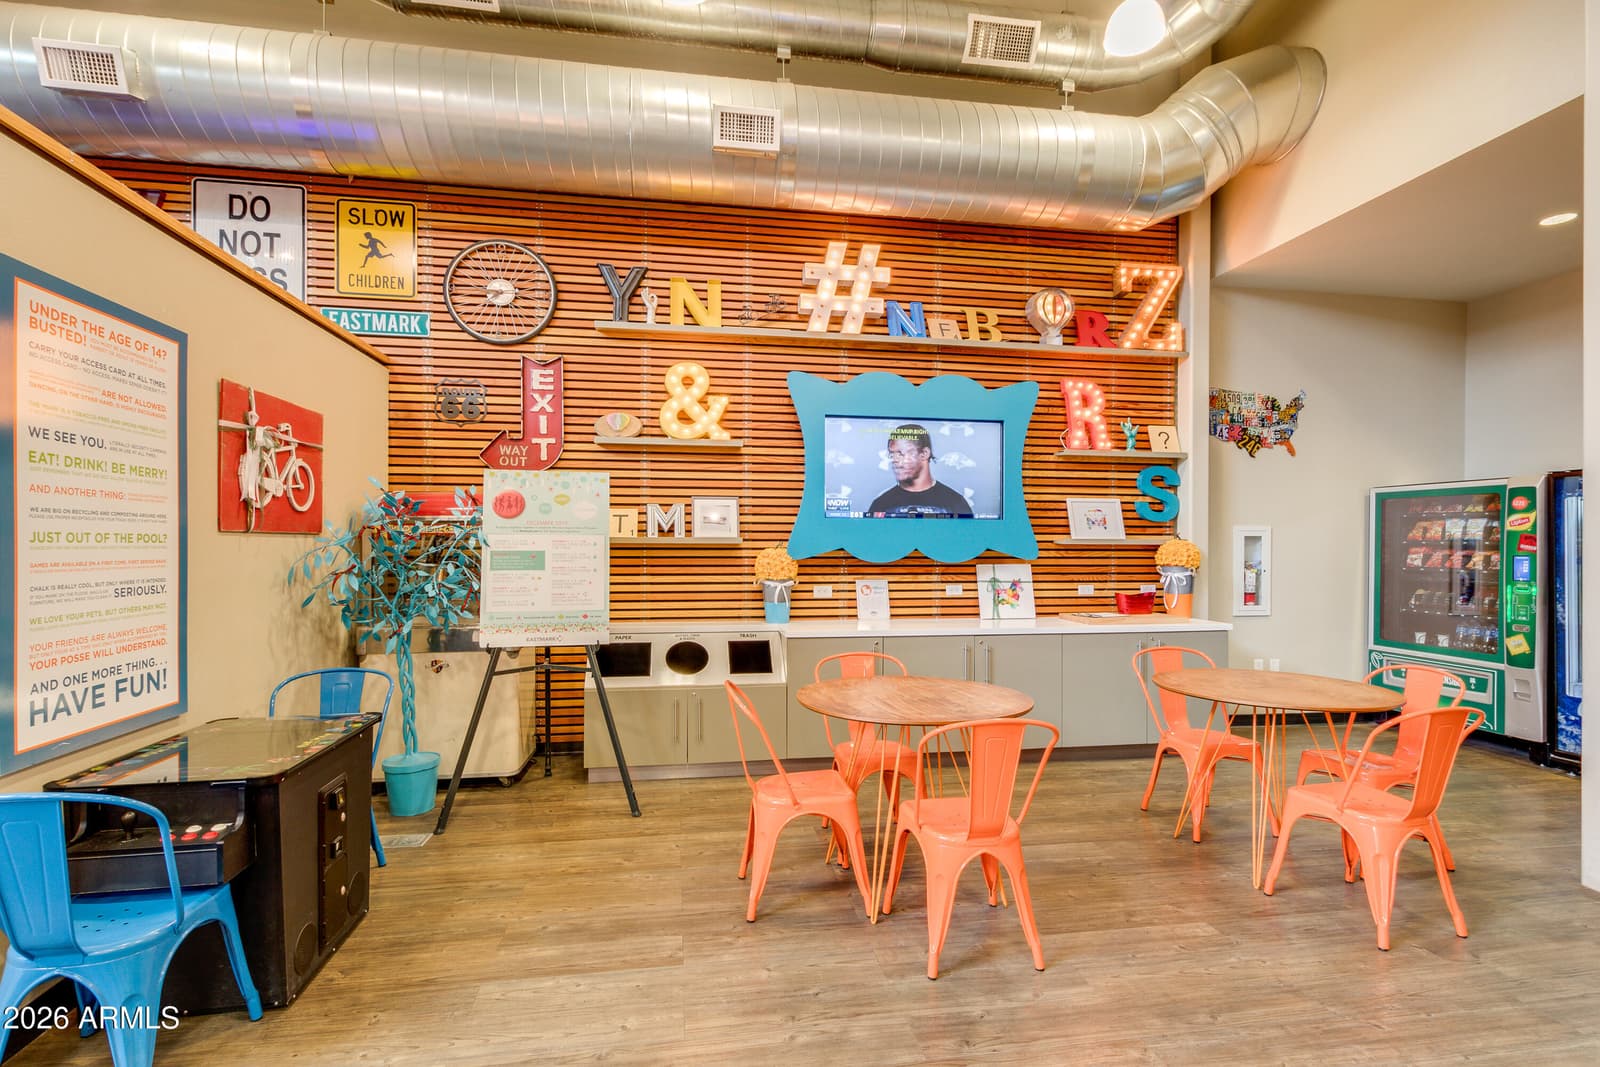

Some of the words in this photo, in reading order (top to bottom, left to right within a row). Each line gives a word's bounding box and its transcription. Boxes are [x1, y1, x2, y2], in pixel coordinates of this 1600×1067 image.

[228, 193, 271, 222] DO
[348, 208, 406, 228] SLOW
[219, 229, 281, 258] NOT
[348, 273, 405, 290] CHILDREN
[598, 263, 648, 322] Y
[670, 276, 722, 327] N
[886, 300, 927, 338] N
[960, 307, 1002, 342] B
[1075, 310, 1119, 348] R
[1113, 262, 1184, 350] Z
[30, 299, 78, 328] UNDER
[82, 320, 105, 338] THE
[109, 330, 131, 348] AGE
[134, 340, 149, 352] OF
[152, 346, 167, 360] 14?
[30, 316, 87, 347] BUSTED!
[328, 310, 422, 333] EASTMARK
[29, 341, 56, 355] CARRY
[59, 350, 80, 360] YOUR
[81, 358, 107, 371] ACCESS
[108, 366, 126, 376] CARD
[102, 389, 116, 399] ARE
[118, 394, 133, 404] NOT
[441, 396, 481, 419] 66
[660, 362, 731, 440] &
[530, 368, 556, 461] EXIT
[1060, 377, 1112, 450] R
[28, 426, 49, 440] WE
[54, 430, 76, 444] SEE
[80, 435, 107, 450] YOU.
[500, 445, 528, 456] WAY
[28, 450, 60, 466] EAT!
[64, 455, 108, 472] DRINK!
[112, 463, 126, 474] BE
[129, 466, 168, 480] MERRY!
[499, 456, 528, 466] OUT
[29, 483, 50, 494] AND
[54, 487, 96, 498] ANOTHER
[1134, 465, 1181, 522] S
[647, 504, 685, 538] M
[29, 531, 62, 543] JUST
[66, 532, 91, 543] OUT
[94, 532, 110, 543] OF
[113, 533, 134, 543] THE
[137, 533, 167, 544] POOL?
[114, 584, 167, 598] SERIOUSLY.
[44, 615, 64, 623] LOVE
[29, 658, 57, 671] YOUR
[61, 652, 90, 665] POSSE
[93, 648, 113, 659] WILL
[116, 638, 167, 654] UNDERSTAND.
[30, 641, 53, 652] YOUR
[56, 635, 89, 648] FRIENDS
[91, 632, 105, 642] ARE
[108, 628, 134, 640] ALWAYS
[30, 679, 58, 695] AND
[62, 672, 88, 687] ONE
[91, 665, 123, 680] MORE
[30, 683, 106, 727] HAVE
[115, 668, 167, 702] FUN!
